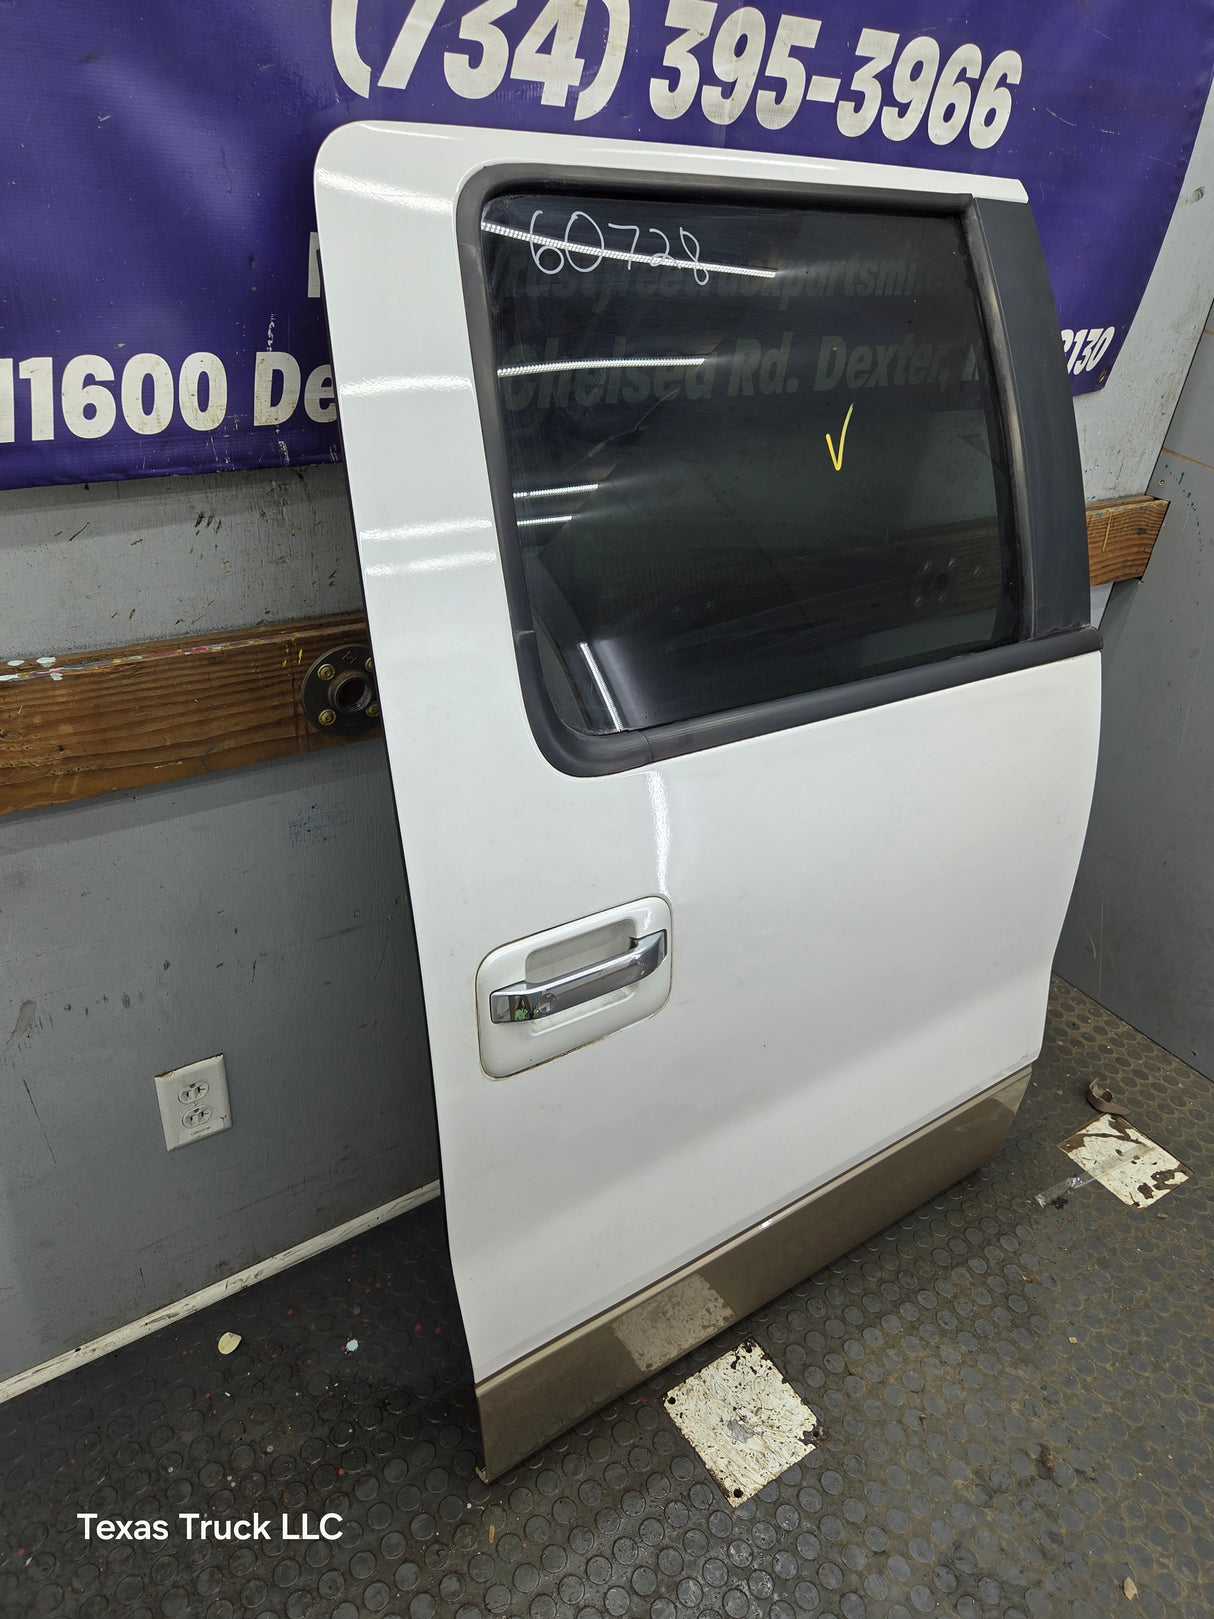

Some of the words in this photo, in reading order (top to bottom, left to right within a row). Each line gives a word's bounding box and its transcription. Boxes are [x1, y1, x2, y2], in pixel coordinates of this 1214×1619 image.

[649, 0, 1023, 149] 395-3966
[529, 210, 710, 286] 60728
[727, 331, 799, 398] Rd.
